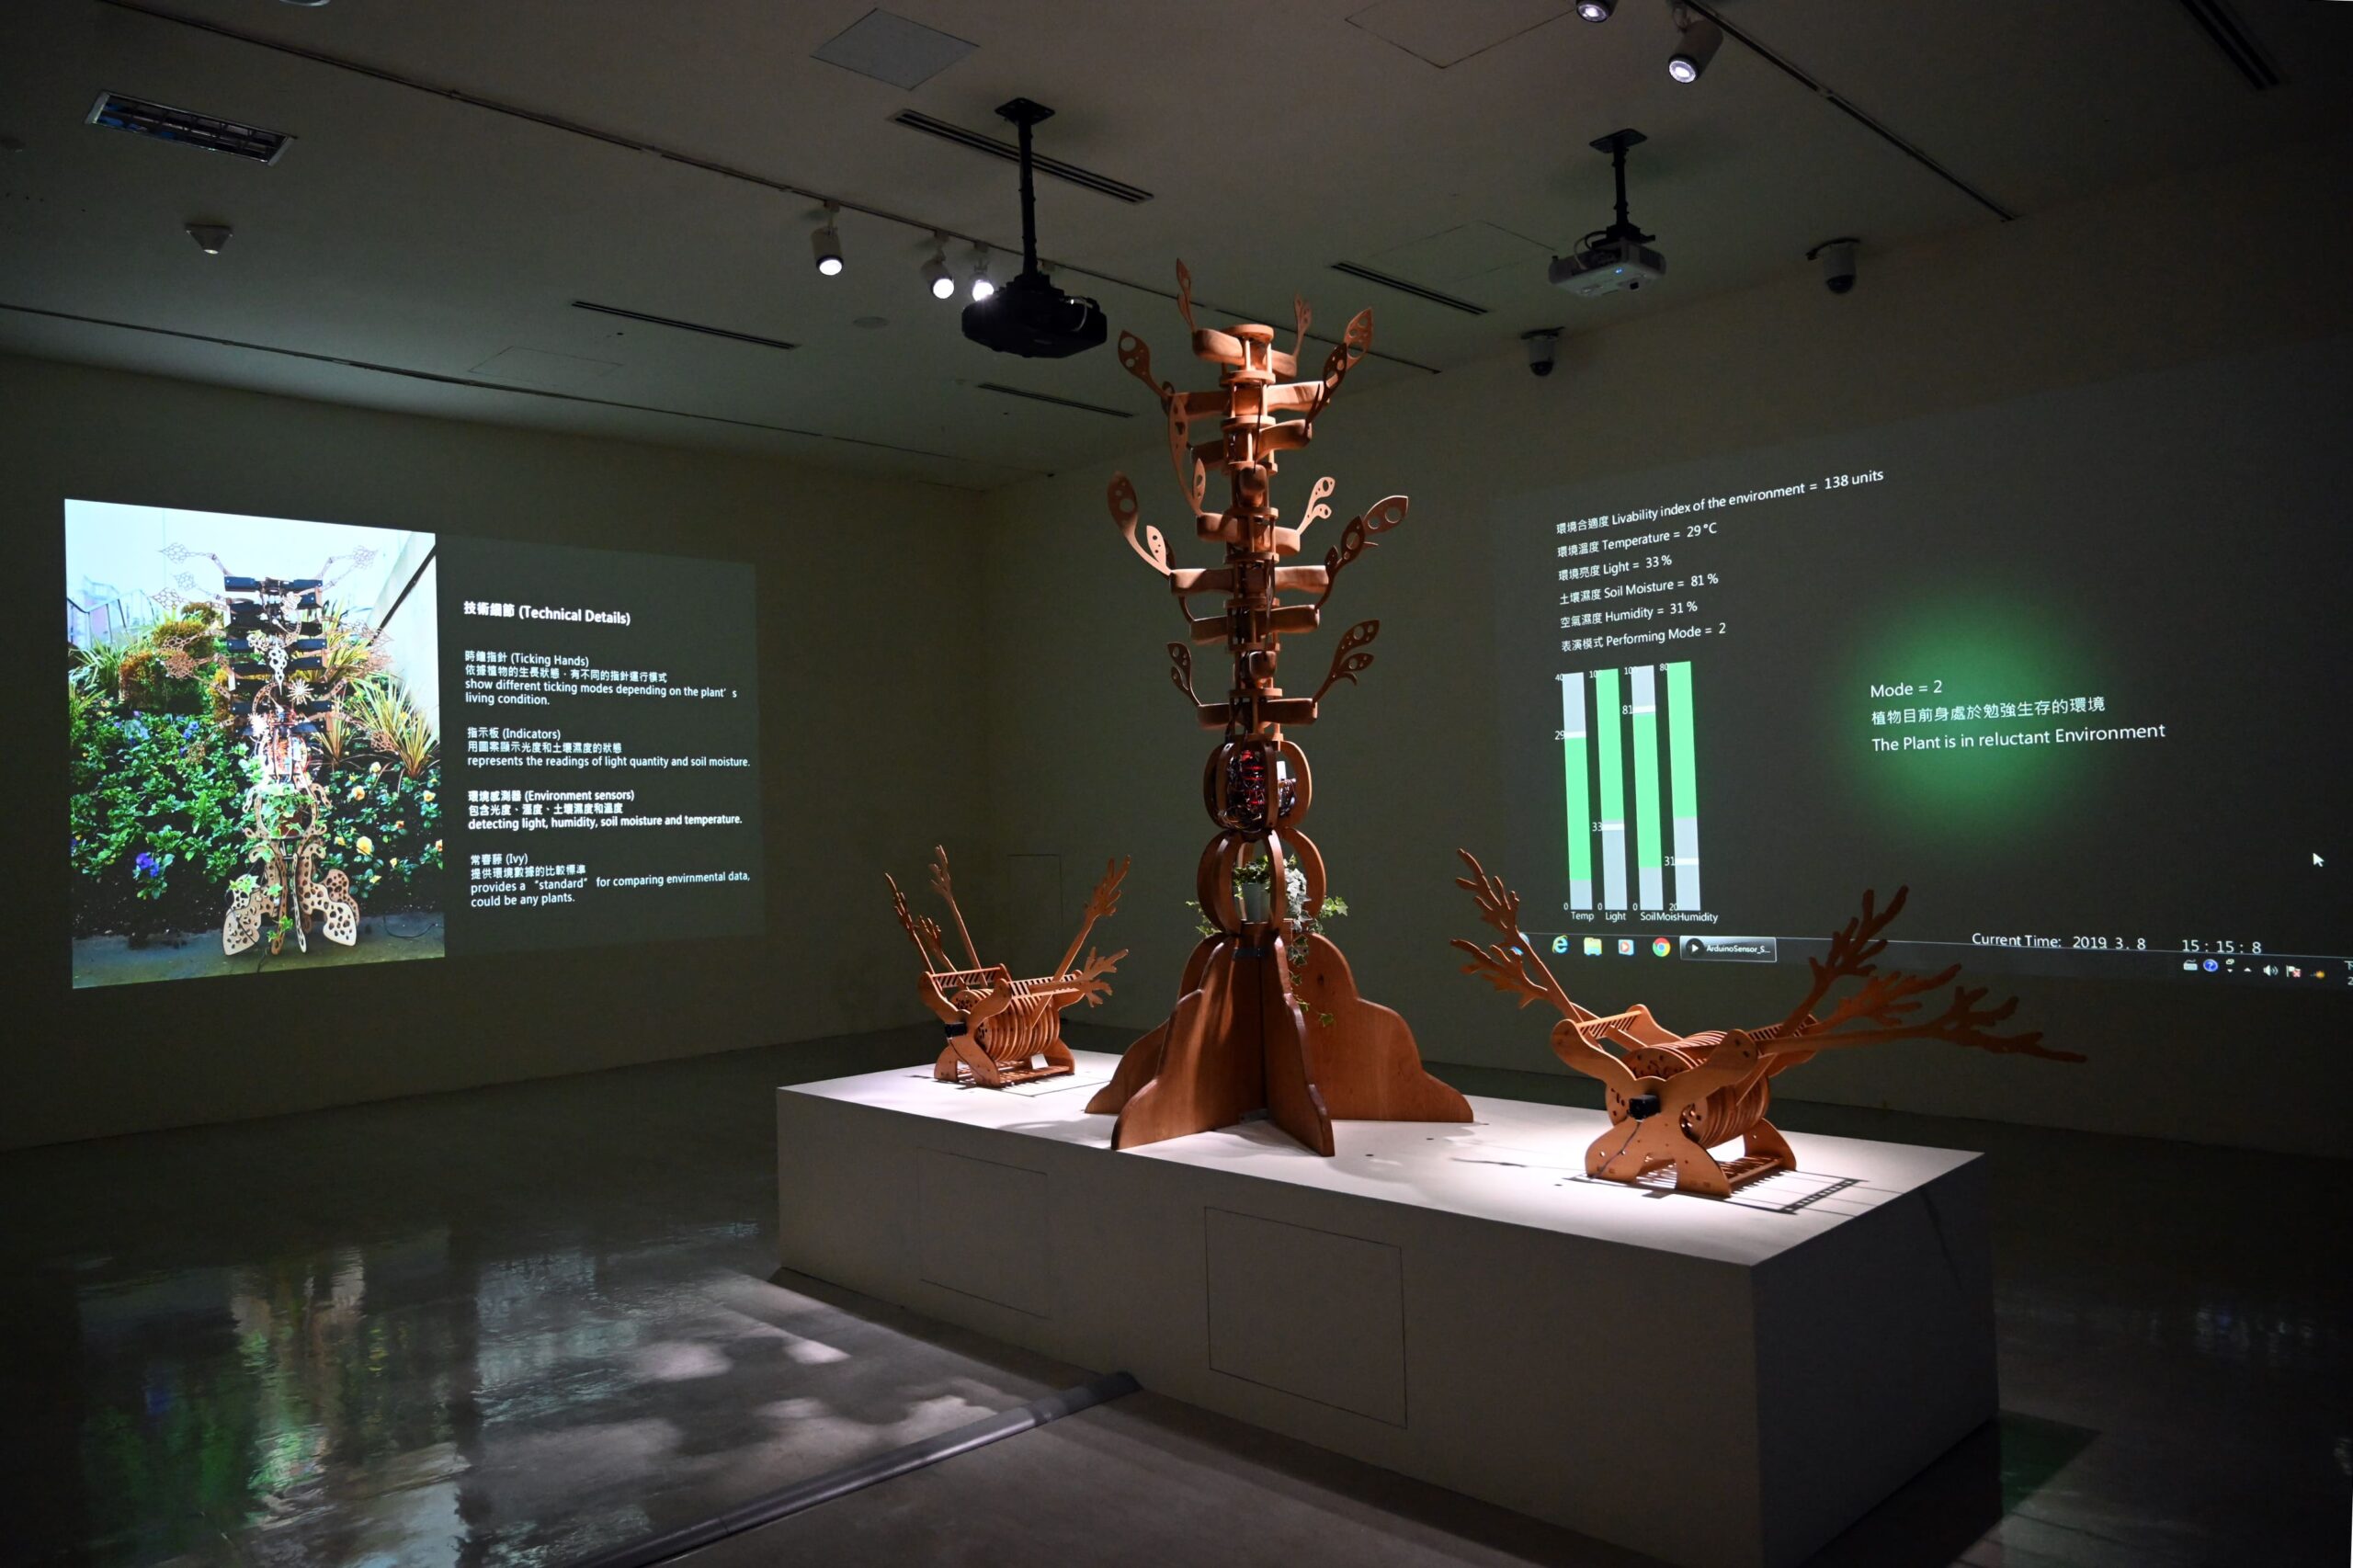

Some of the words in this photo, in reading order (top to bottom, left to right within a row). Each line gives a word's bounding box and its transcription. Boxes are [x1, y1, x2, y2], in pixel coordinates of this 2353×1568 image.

[1612, 508, 1657, 526] Livability
[1661, 503, 1691, 517] index
[1694, 500, 1705, 511] of
[1708, 496, 1726, 509] the
[1729, 483, 1805, 506] environment
[1824, 476, 1848, 490] 138
[1852, 470, 1883, 484] units
[1602, 529, 1669, 554] Temperature
[1687, 526, 1701, 538] 29
[1703, 523, 1717, 534] °C
[1559, 565, 1600, 581] 環境亮度
[1603, 562, 1629, 577] Light
[1645, 558, 1659, 569] 33
[1605, 585, 1622, 598] Soil
[1626, 579, 1674, 596] Moisture
[1690, 576, 1704, 586] 81
[518, 605, 582, 622] (Technical
[585, 609, 631, 626] Details)
[1606, 608, 1654, 623] Humidity
[1670, 604, 1683, 615] 31
[1562, 636, 1603, 653] 表演模式
[1607, 630, 1665, 647] Performing
[1668, 626, 1701, 639] Mode
[1718, 623, 1726, 635] 2
[511, 653, 551, 666] (Ticking
[554, 655, 589, 667] Hands)
[1624, 665, 1638, 675] 10
[465, 679, 493, 690] show
[496, 679, 540, 692] different
[544, 682, 577, 695] ticking
[580, 682, 613, 694] modes
[617, 684, 666, 698] depending
[669, 686, 681, 696] on
[684, 685, 698, 697] the
[1870, 683, 1913, 698] Mode
[1933, 680, 1942, 693] 2
[465, 693, 494, 706] living
[497, 694, 550, 706] condition.
[1622, 705, 1632, 714] 81
[502, 727, 561, 740] (Indicators)
[1555, 730, 1564, 740] 29
[1872, 737, 1898, 752] The
[1904, 735, 1940, 750] Plant
[1945, 735, 1956, 748] is
[1961, 734, 1973, 747] in
[1979, 732, 2050, 747] reluctant
[2055, 723, 2165, 744] Environment
[468, 756, 523, 768] represents
[527, 756, 543, 767] the
[546, 756, 589, 768] readings
[592, 756, 602, 767] of
[605, 756, 627, 768] light
[630, 756, 668, 769] quantity
[672, 756, 688, 767] and
[691, 756, 707, 767] soil
[710, 757, 750, 767] moisture.
[524, 790, 592, 802] (Environment
[595, 790, 635, 801] sensors)
[468, 816, 518, 831] detecting
[522, 816, 549, 830] light,
[551, 816, 598, 829] humidity,
[601, 815, 618, 827] soil
[620, 815, 662, 826] moisture
[665, 814, 682, 825] and
[685, 814, 743, 827] temperature.
[1592, 822, 1602, 832] 33
[506, 853, 528, 865] (Ivy)
[1665, 857, 1675, 866] 31
[472, 880, 517, 895] provides
[519, 881, 526, 891] a
[597, 875, 610, 888] for
[613, 875, 664, 889] comparing
[728, 871, 751, 883] data,
[472, 895, 501, 907] could
[504, 894, 517, 906] be
[520, 894, 538, 907] any
[541, 892, 575, 906] plants.
[1632, 903, 1638, 911] 0
[1572, 912, 1594, 922] Temp
[1606, 912, 1626, 923] Light
[1677, 913, 1718, 924] Humidity
[1972, 933, 2021, 948] Current
[2024, 935, 2062, 948] Time:
[2137, 937, 2145, 949] 8
